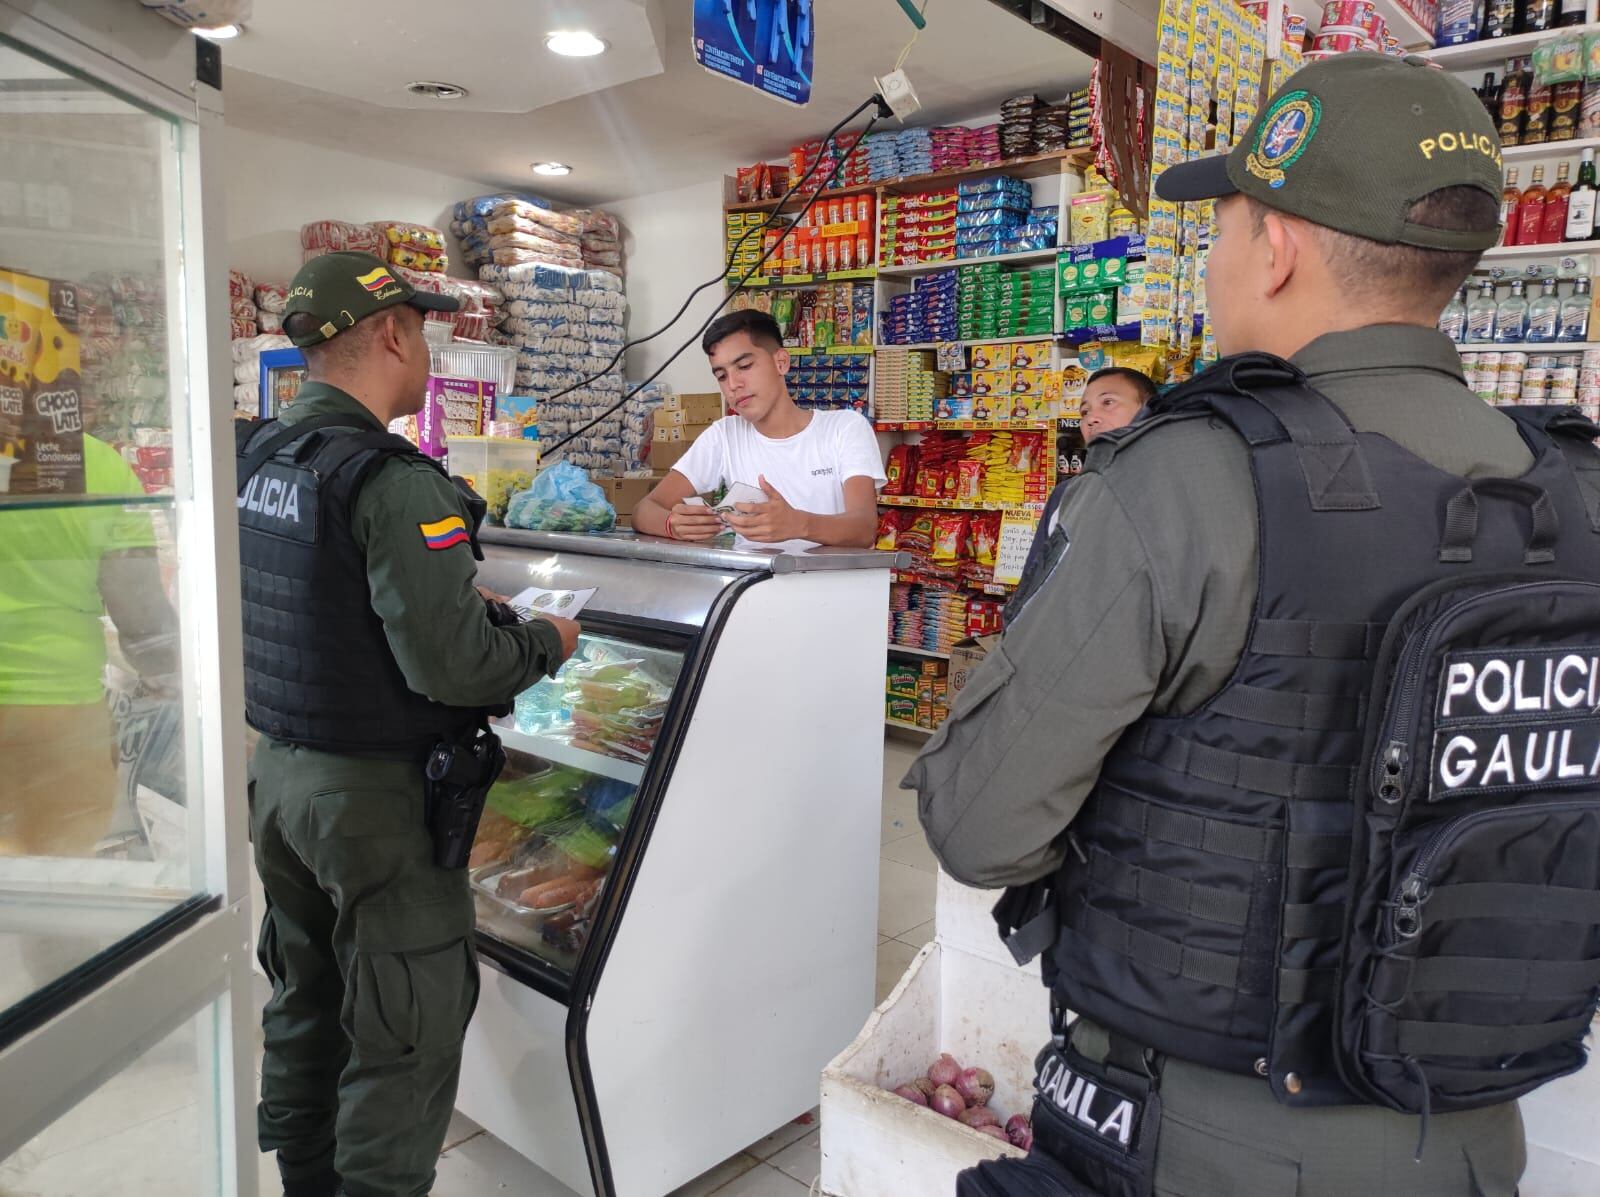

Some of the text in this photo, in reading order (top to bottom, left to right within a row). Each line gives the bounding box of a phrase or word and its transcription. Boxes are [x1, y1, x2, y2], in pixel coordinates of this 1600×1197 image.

[59, 290, 74, 308] 12
[53, 410, 81, 433] LATE
[1005, 509, 1032, 517] NUEVA
[1442, 654, 1600, 717] POLICI
[1039, 1055, 1134, 1144] GAULA
